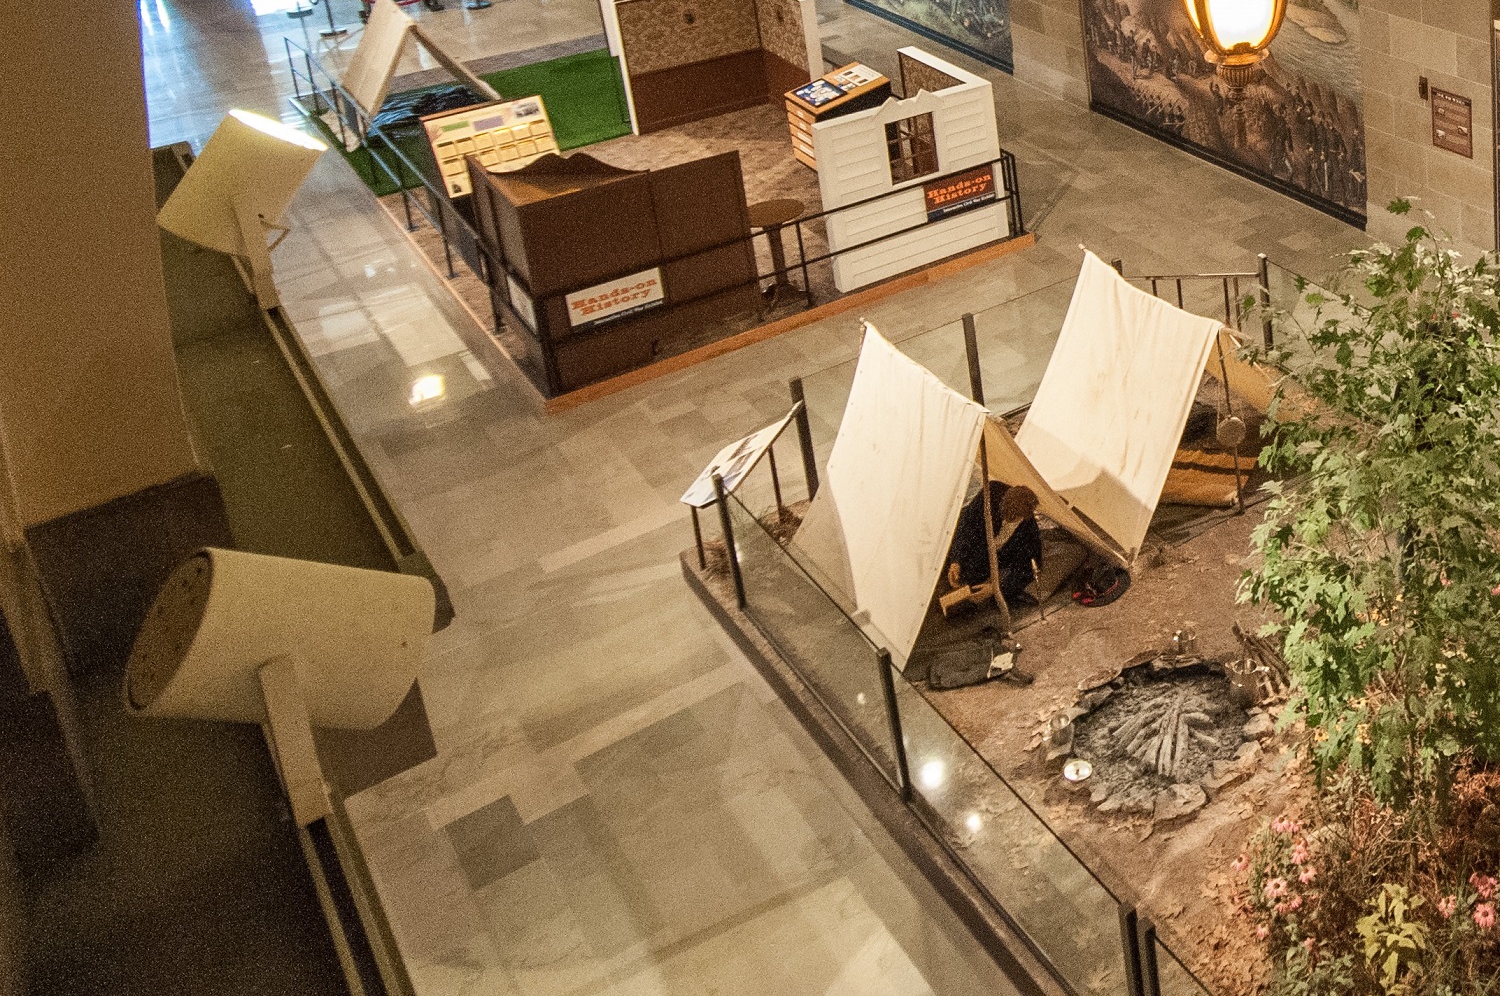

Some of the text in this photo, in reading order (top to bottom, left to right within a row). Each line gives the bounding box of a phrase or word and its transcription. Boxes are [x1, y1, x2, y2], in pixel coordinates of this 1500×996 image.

[927, 174, 992, 199] Hands-on
[933, 182, 987, 205] History
[571, 279, 657, 311] Hands-on
[581, 288, 651, 316] History
